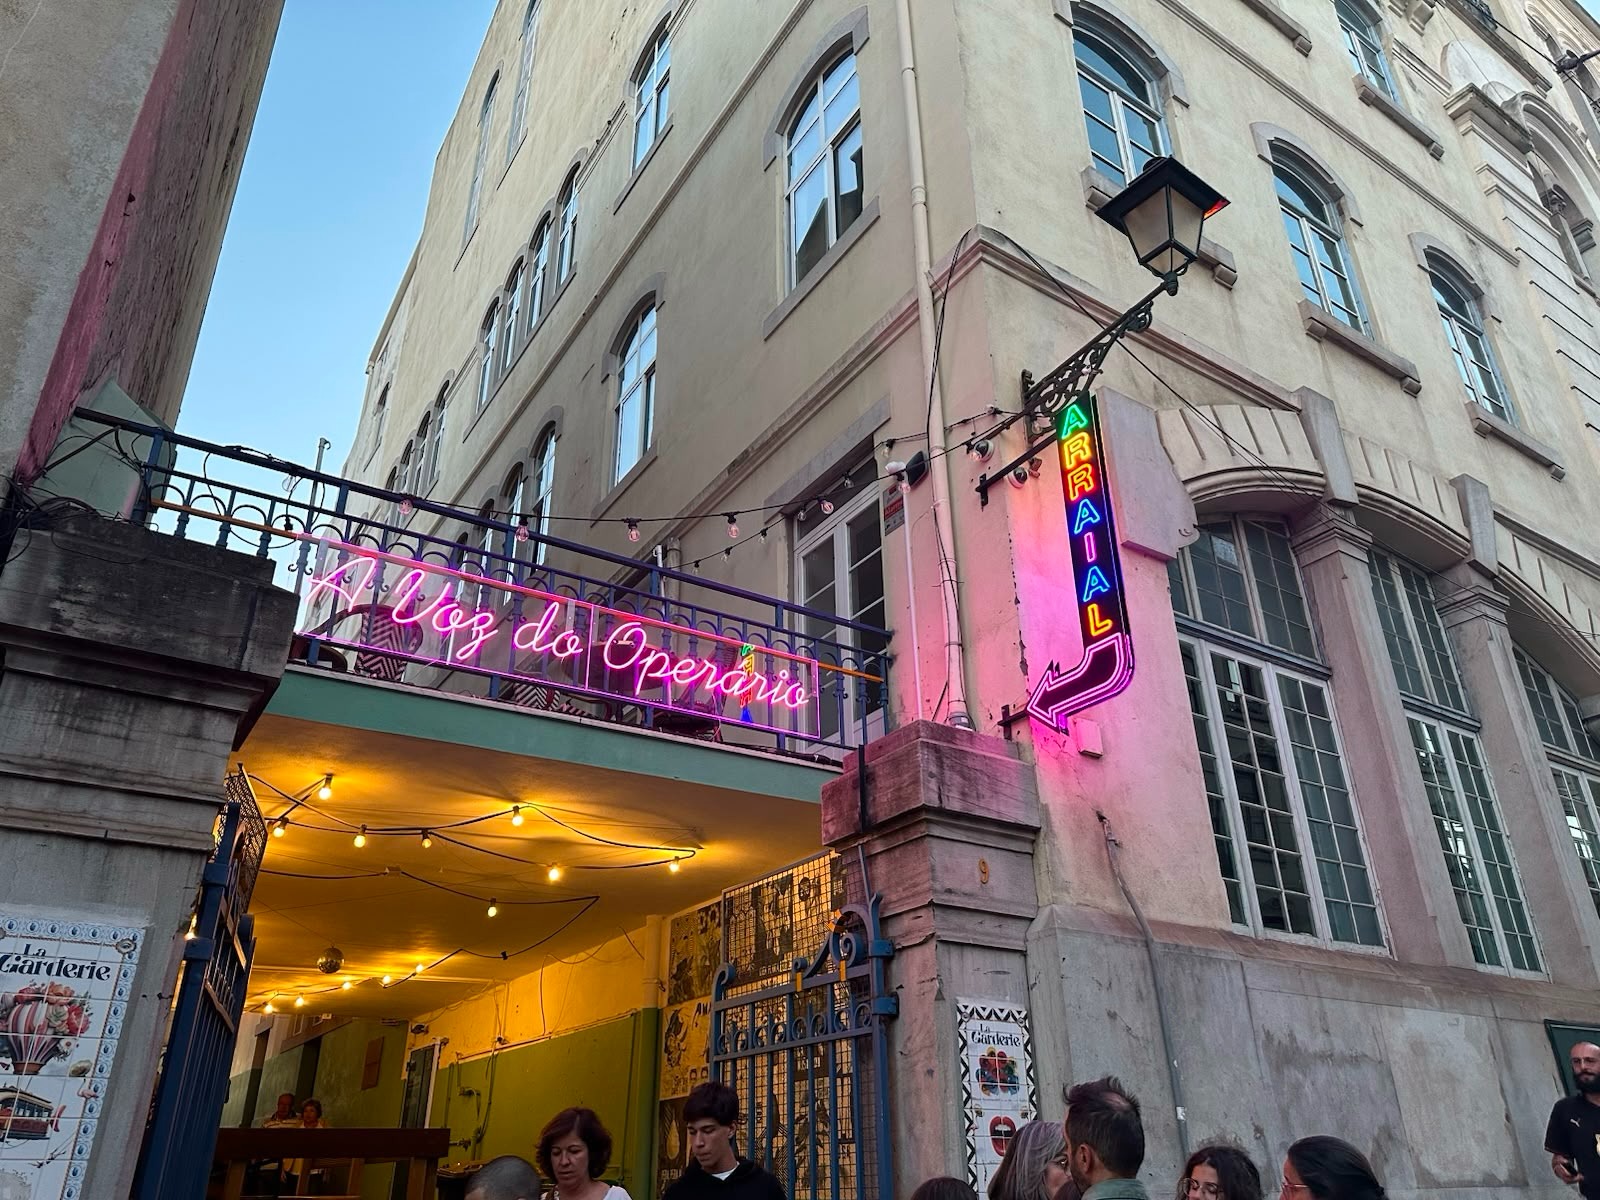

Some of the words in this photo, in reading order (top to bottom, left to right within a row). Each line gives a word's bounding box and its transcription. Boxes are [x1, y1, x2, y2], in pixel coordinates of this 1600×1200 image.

[1060, 402, 1114, 638] ARRAIAL
[306, 557, 378, 612] A
[392, 567, 501, 662] Voz
[512, 601, 585, 658] do
[602, 621, 811, 709] Operário
[978, 858, 990, 885] 9
[23, 943, 47, 957] La
[0, 954, 111, 981] Garderie
[971, 1030, 1021, 1047] Garderie
[980, 1023, 991, 1033] La
